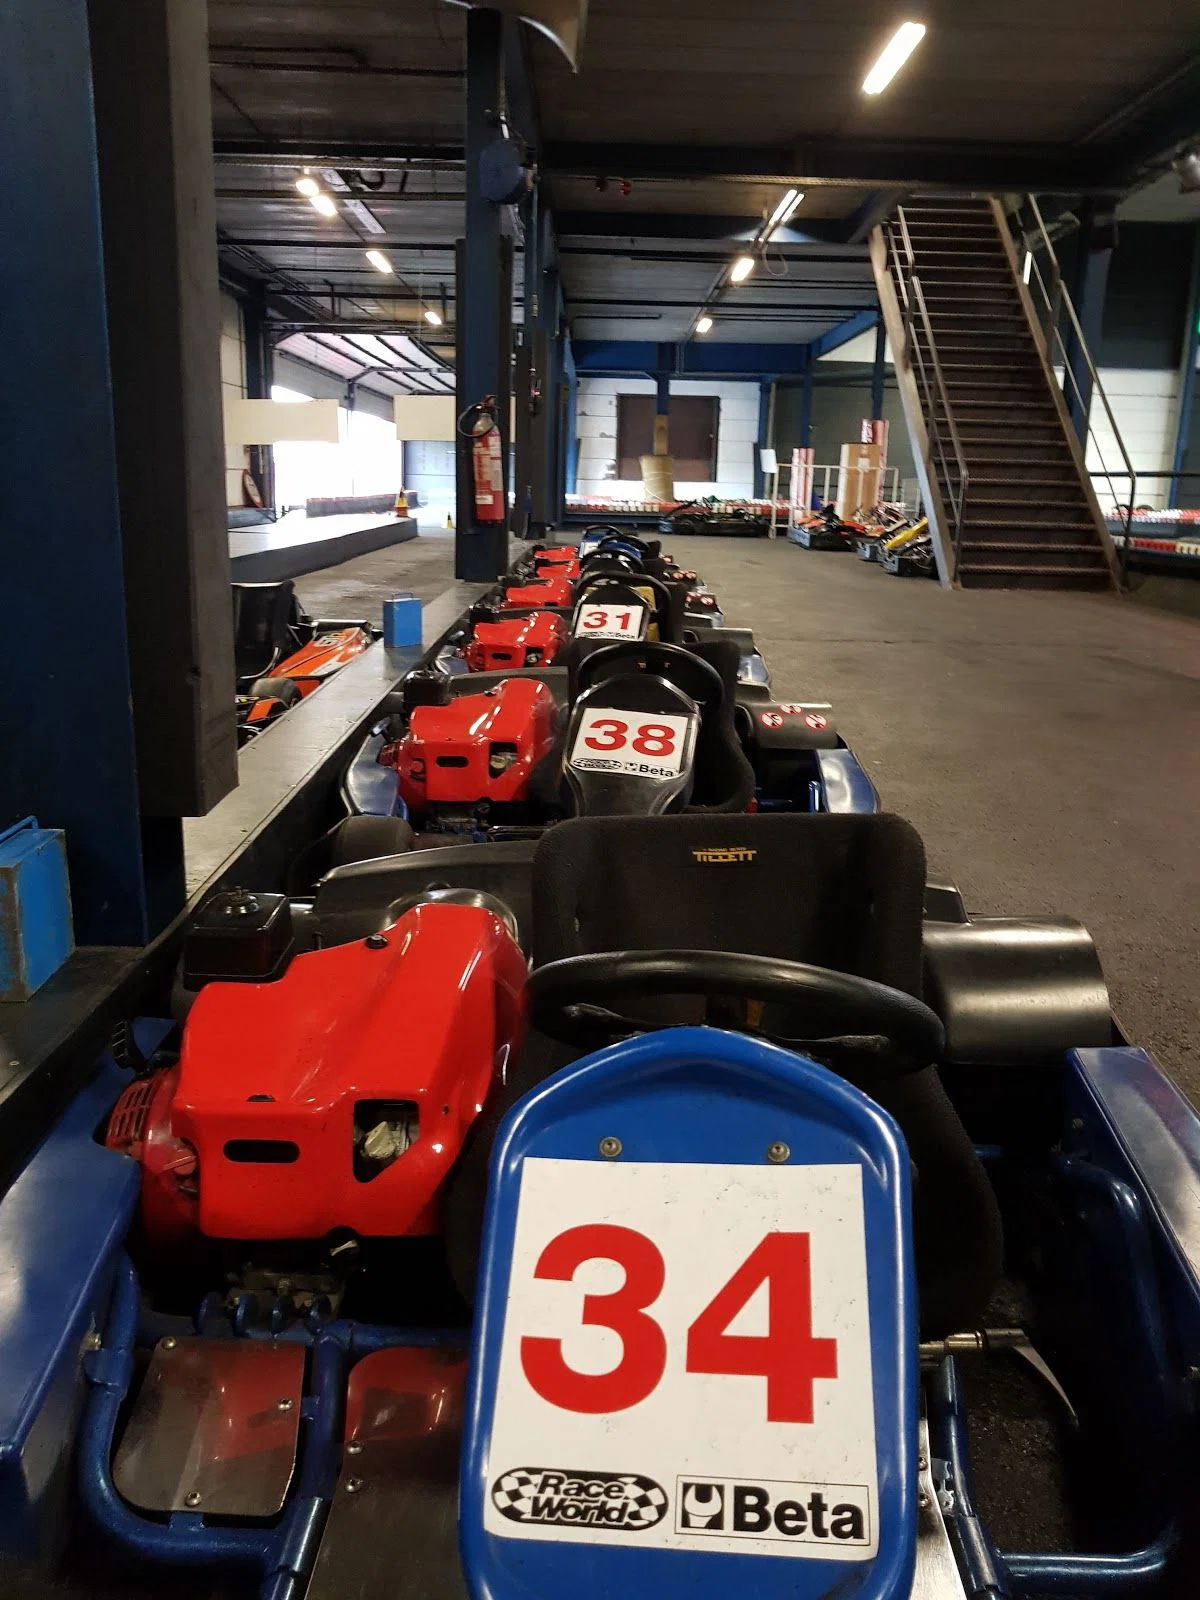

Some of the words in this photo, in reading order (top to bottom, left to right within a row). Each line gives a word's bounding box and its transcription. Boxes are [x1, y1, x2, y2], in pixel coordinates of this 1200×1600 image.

[583, 611, 632, 630] 31
[584, 719, 675, 757] 38
[639, 764, 674, 778] Beta
[520, 1223, 837, 1424] 34
[536, 1472, 626, 1500] Race
[529, 1495, 629, 1525] World
[733, 1484, 865, 1540] Beta
